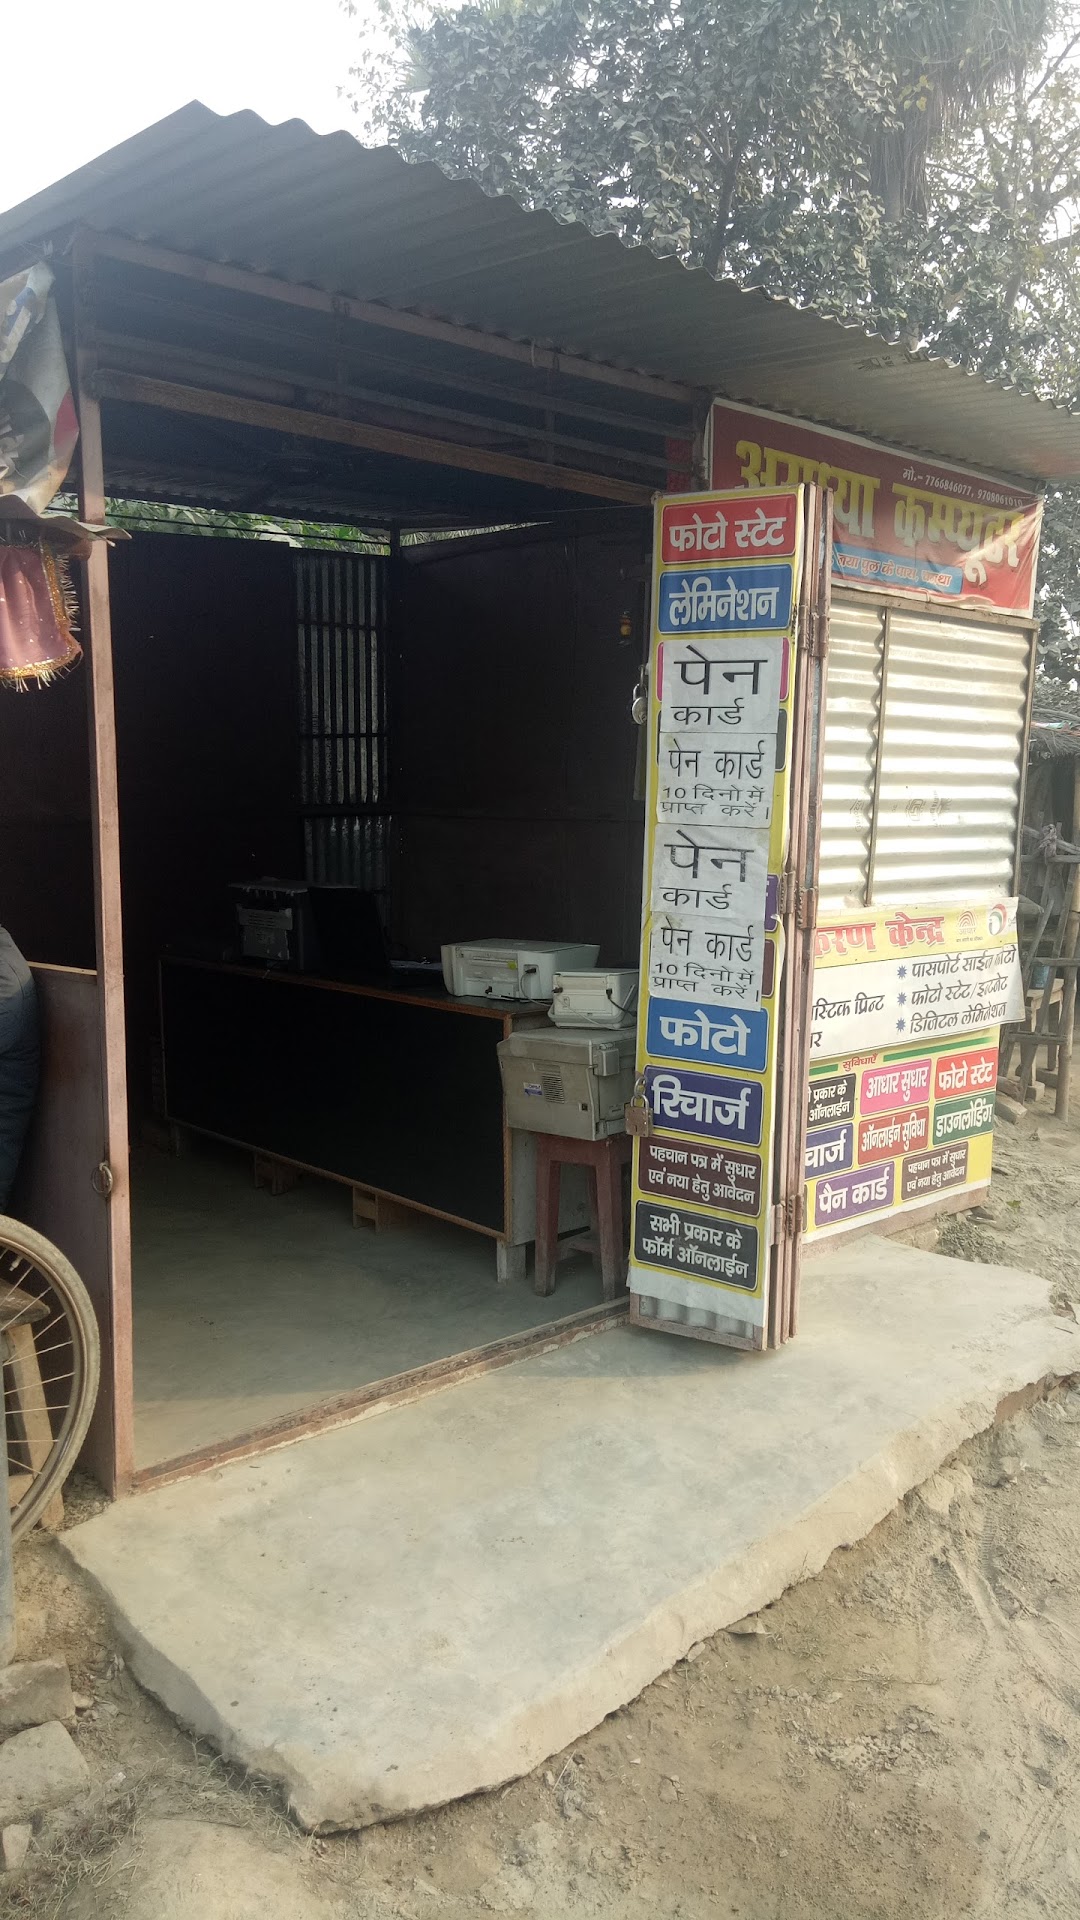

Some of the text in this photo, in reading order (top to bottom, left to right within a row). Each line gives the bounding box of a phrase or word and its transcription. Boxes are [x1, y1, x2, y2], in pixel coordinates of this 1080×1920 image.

[669, 507, 786, 551] फोटो स्टेट
[669, 576, 779, 626] लेमिनेशन
[674, 645, 768, 695] पेन
[670, 697, 745, 726] कार्ड
[668, 738, 765, 779] पेन कार्ड
[660, 801, 708, 816] प्राप्त
[662, 784, 766, 803] 10 दिनो में
[664, 829, 755, 883] पेन
[659, 884, 733, 910] कार्ड
[661, 916, 755, 962] पेन कार्ड
[885, 911, 945, 947] केन्द्र
[655, 962, 756, 985] 10 दिनो में
[912, 952, 962, 978] पासपोर्ट
[652, 976, 700, 993] प्राप्त
[912, 982, 943, 1006] फोटो
[854, 991, 886, 1015] प्रिन्ट
[910, 1000, 1008, 1034] डिजिटल लेमिनेशन
[659, 1009, 751, 1057] फोटो
[866, 1066, 929, 1102] आधार सुधार
[938, 1056, 994, 1091] फोटो स्टेट
[651, 1074, 751, 1130] रिचार्ज
[809, 1098, 850, 1122] ऑनलाईन
[813, 1084, 836, 1104] प्रकार
[837, 1080, 848, 1097] के
[861, 1112, 926, 1152] ऑनलाईन सुविधा
[935, 1098, 994, 1138] डाउनलोडिंग
[650, 1145, 757, 1182] पहचान पत्र में सुधार
[906, 1163, 965, 1192] एवं नया हेतु आवेदन
[908, 1149, 966, 1174] पहचान पत्र में सुधार
[648, 1167, 755, 1204] एवं नया हेतु आवेदन
[819, 1167, 890, 1214] पैन कार्ड
[650, 1212, 743, 1250] सभी प्रकार के
[642, 1236, 749, 1279] फॉर्म ऑनलाईन
